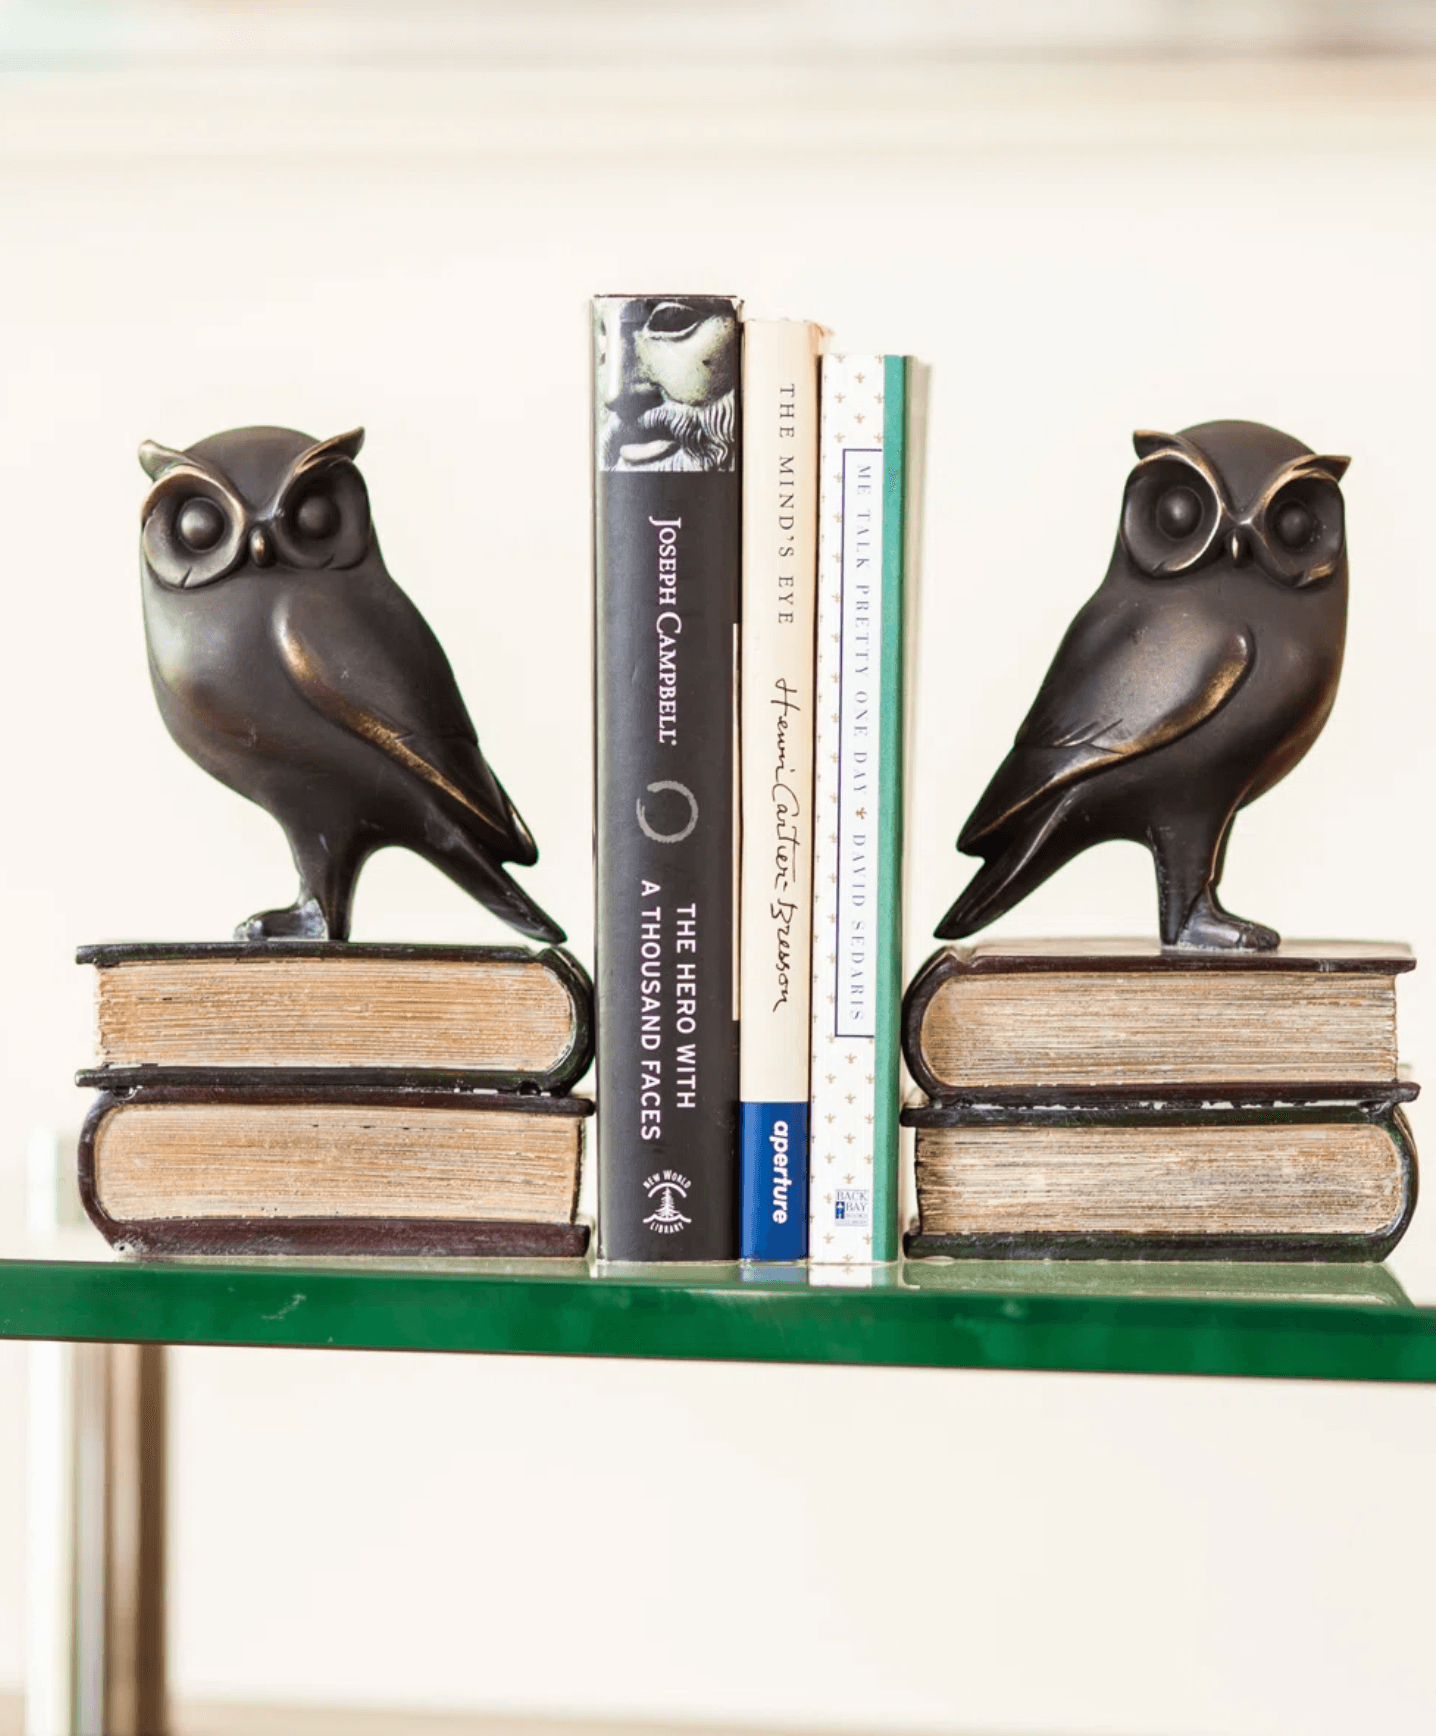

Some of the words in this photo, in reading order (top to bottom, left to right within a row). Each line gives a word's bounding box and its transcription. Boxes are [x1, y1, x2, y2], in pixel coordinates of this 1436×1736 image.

[779, 383, 795, 438] THE
[778, 456, 795, 557] MIND'S
[856, 465, 871, 495] ME
[649, 515, 682, 606] JOSEPH
[856, 509, 871, 569] TALK
[778, 576, 794, 624] EYE
[854, 585, 870, 675] PRETTY
[853, 690, 868, 737] ONE
[853, 752, 868, 793] DAY
[641, 880, 661, 896] A
[852, 834, 867, 907] DAVID
[676, 903, 696, 954] THE
[641, 907, 661, 1050] THOUSAND
[676, 963, 696, 1034] HERO
[850, 920, 866, 1020] SEDARIS
[641, 1060, 661, 1140] FACES
[676, 1044, 696, 1108] WITH
[769, 1120, 792, 1224] aperture
[837, 1191, 869, 1201] BACK
[650, 1221, 684, 1234] LIBRARY
